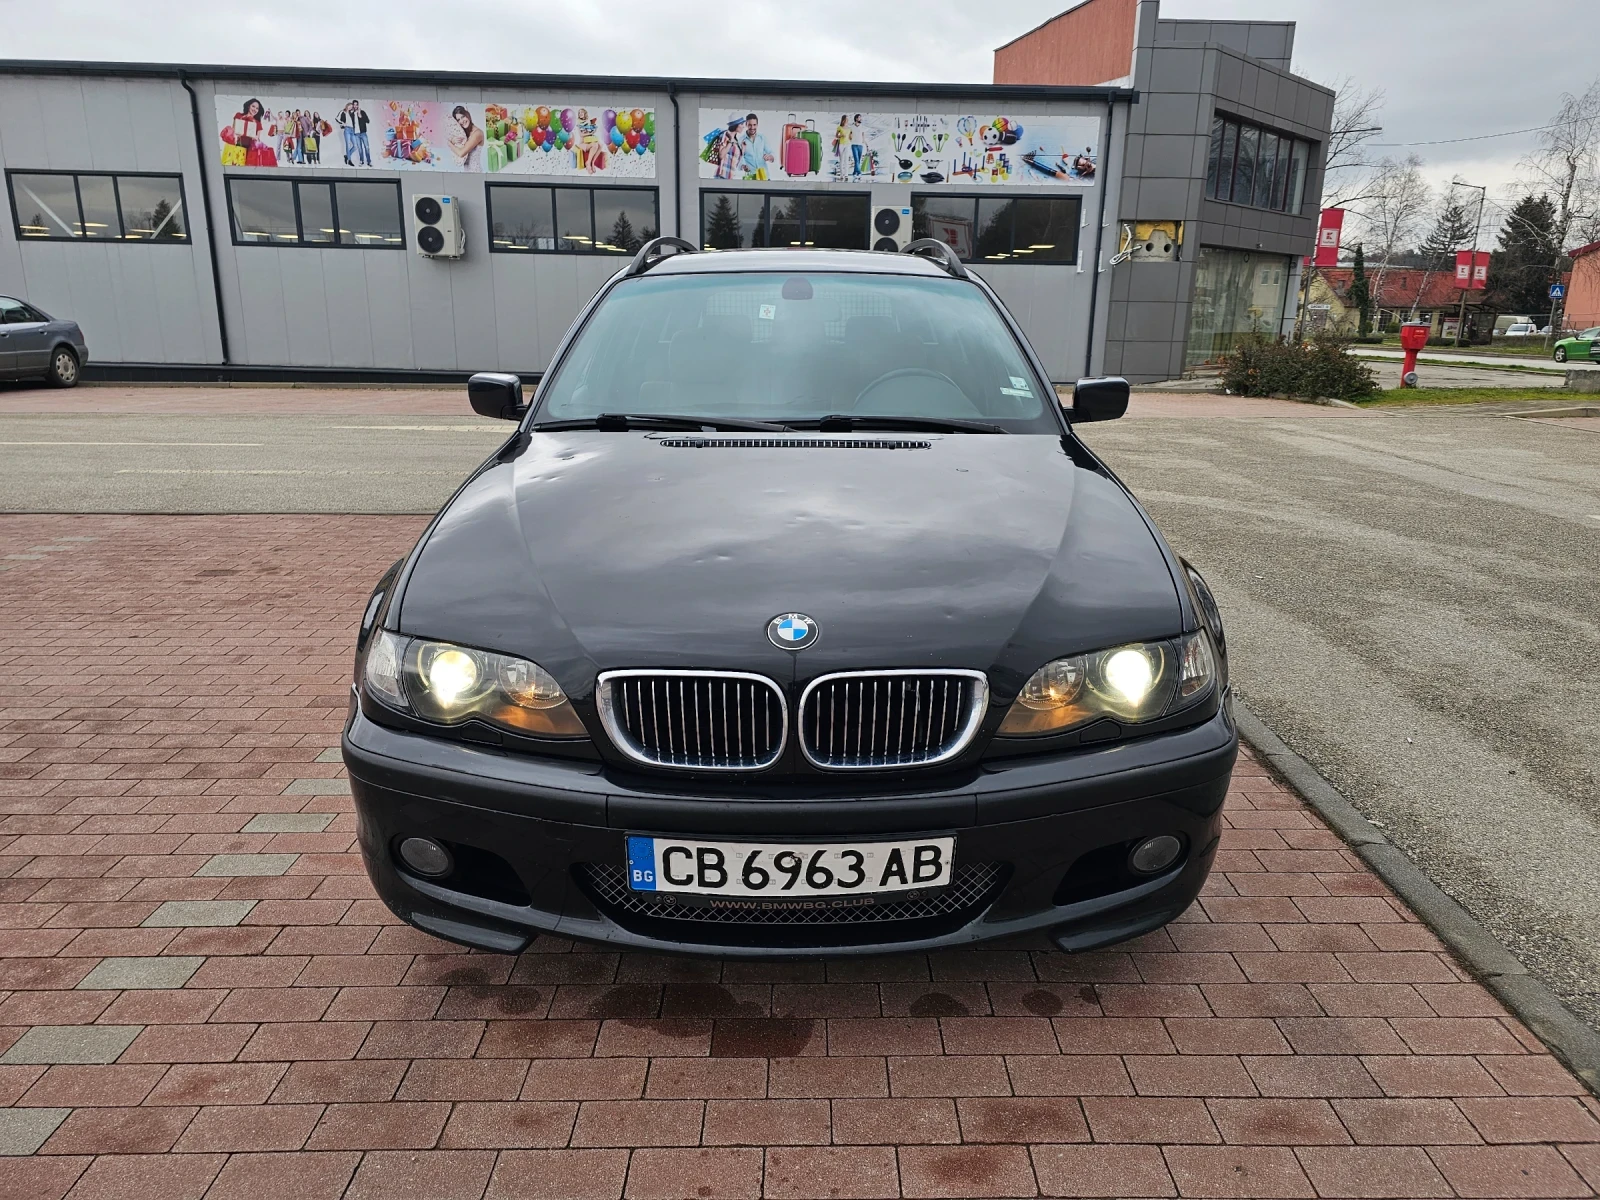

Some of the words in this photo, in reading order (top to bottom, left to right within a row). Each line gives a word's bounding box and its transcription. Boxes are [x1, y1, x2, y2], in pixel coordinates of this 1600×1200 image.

[662, 846, 728, 888] CB
[741, 849, 866, 891] 6963
[878, 845, 944, 887] AB
[633, 870, 653, 882] BG
[710, 898, 875, 909] WWW.BMWBG.CLUB
